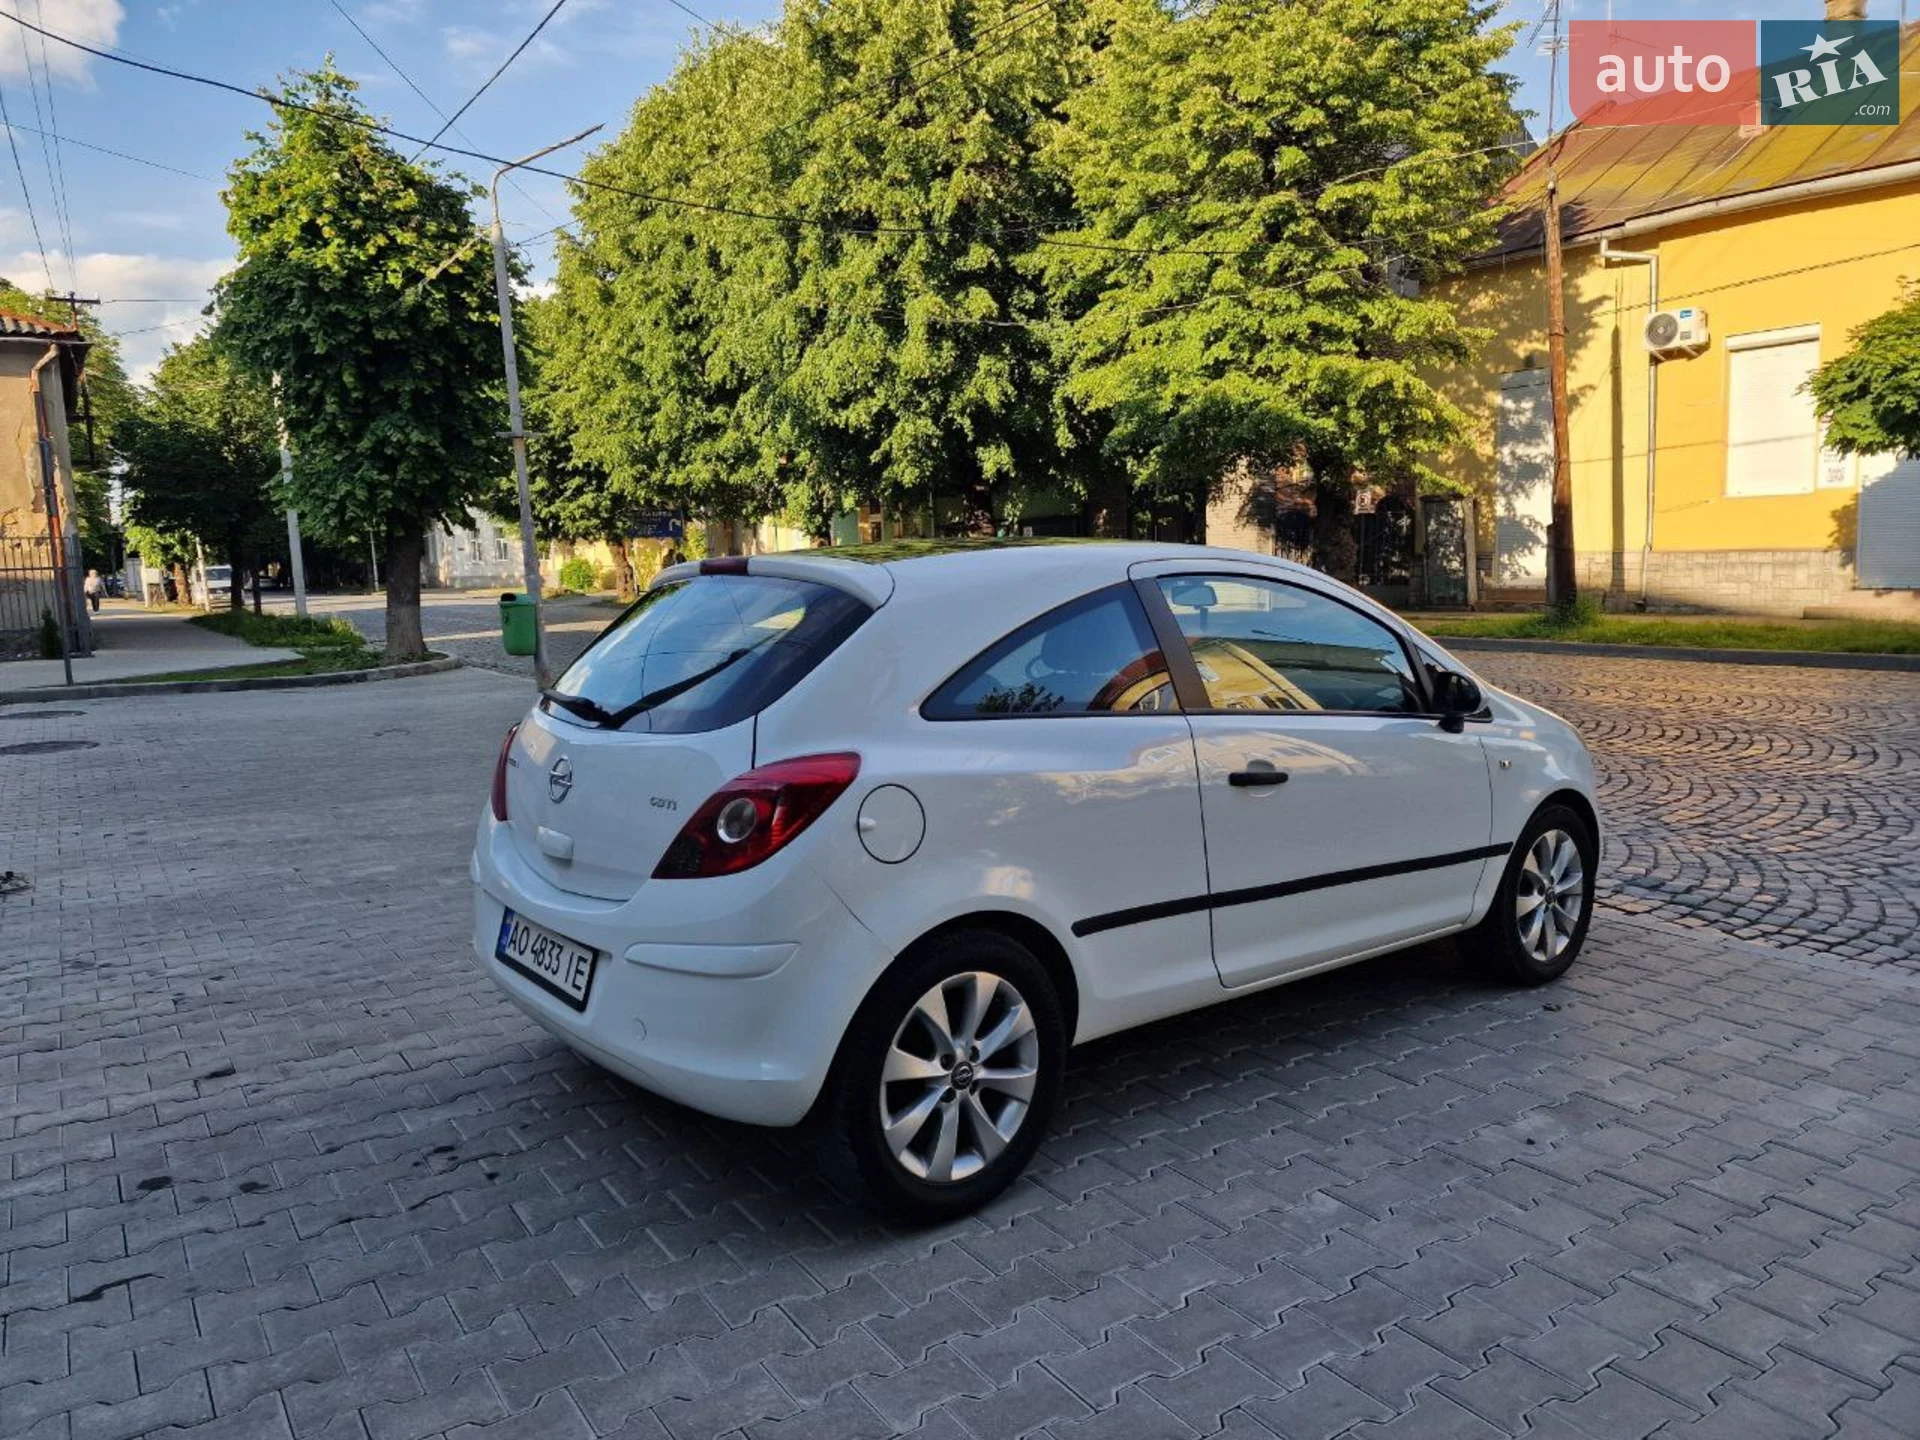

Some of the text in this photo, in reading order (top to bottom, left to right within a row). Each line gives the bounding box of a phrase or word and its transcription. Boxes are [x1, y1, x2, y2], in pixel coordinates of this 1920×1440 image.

[508, 920, 589, 992] AO 4833 IE
